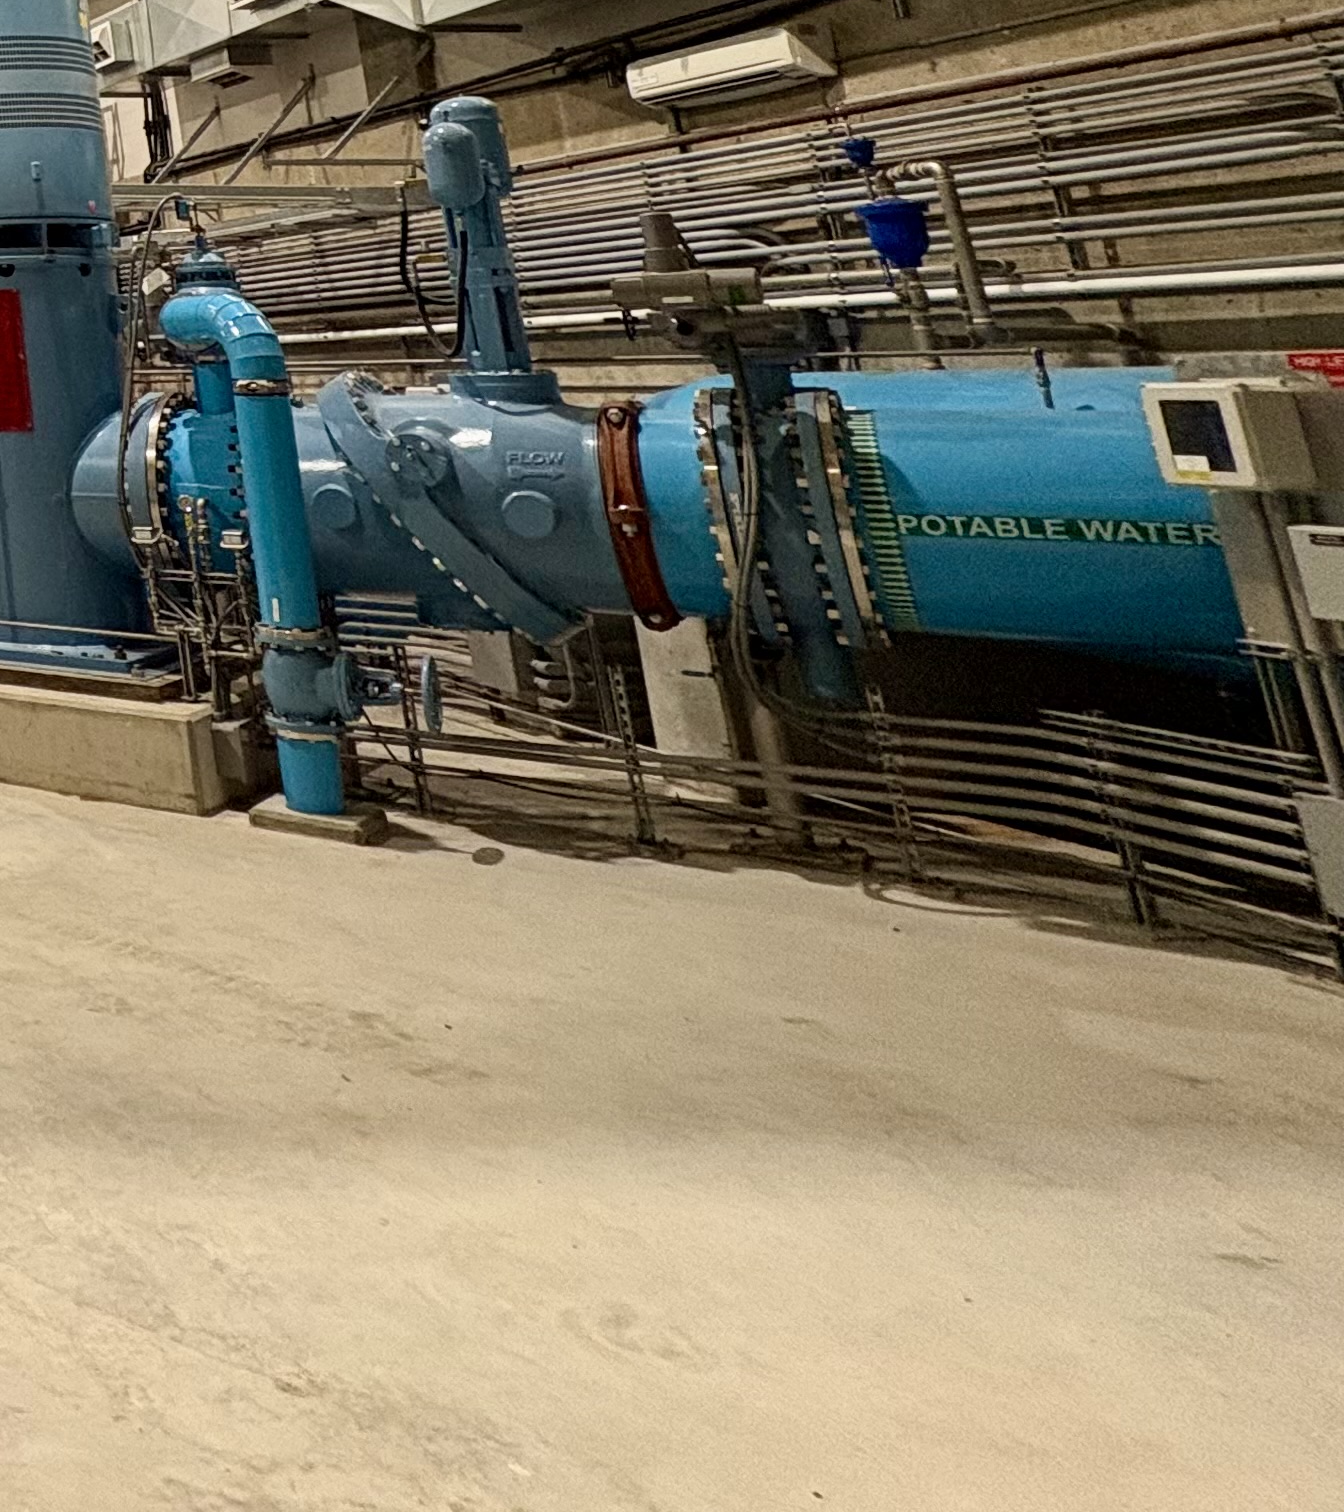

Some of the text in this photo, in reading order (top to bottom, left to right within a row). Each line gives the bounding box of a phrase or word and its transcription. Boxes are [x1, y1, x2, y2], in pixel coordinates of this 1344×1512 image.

[506, 450, 566, 466] FLOW
[896, 514, 1222, 546] POTABLE WATER
